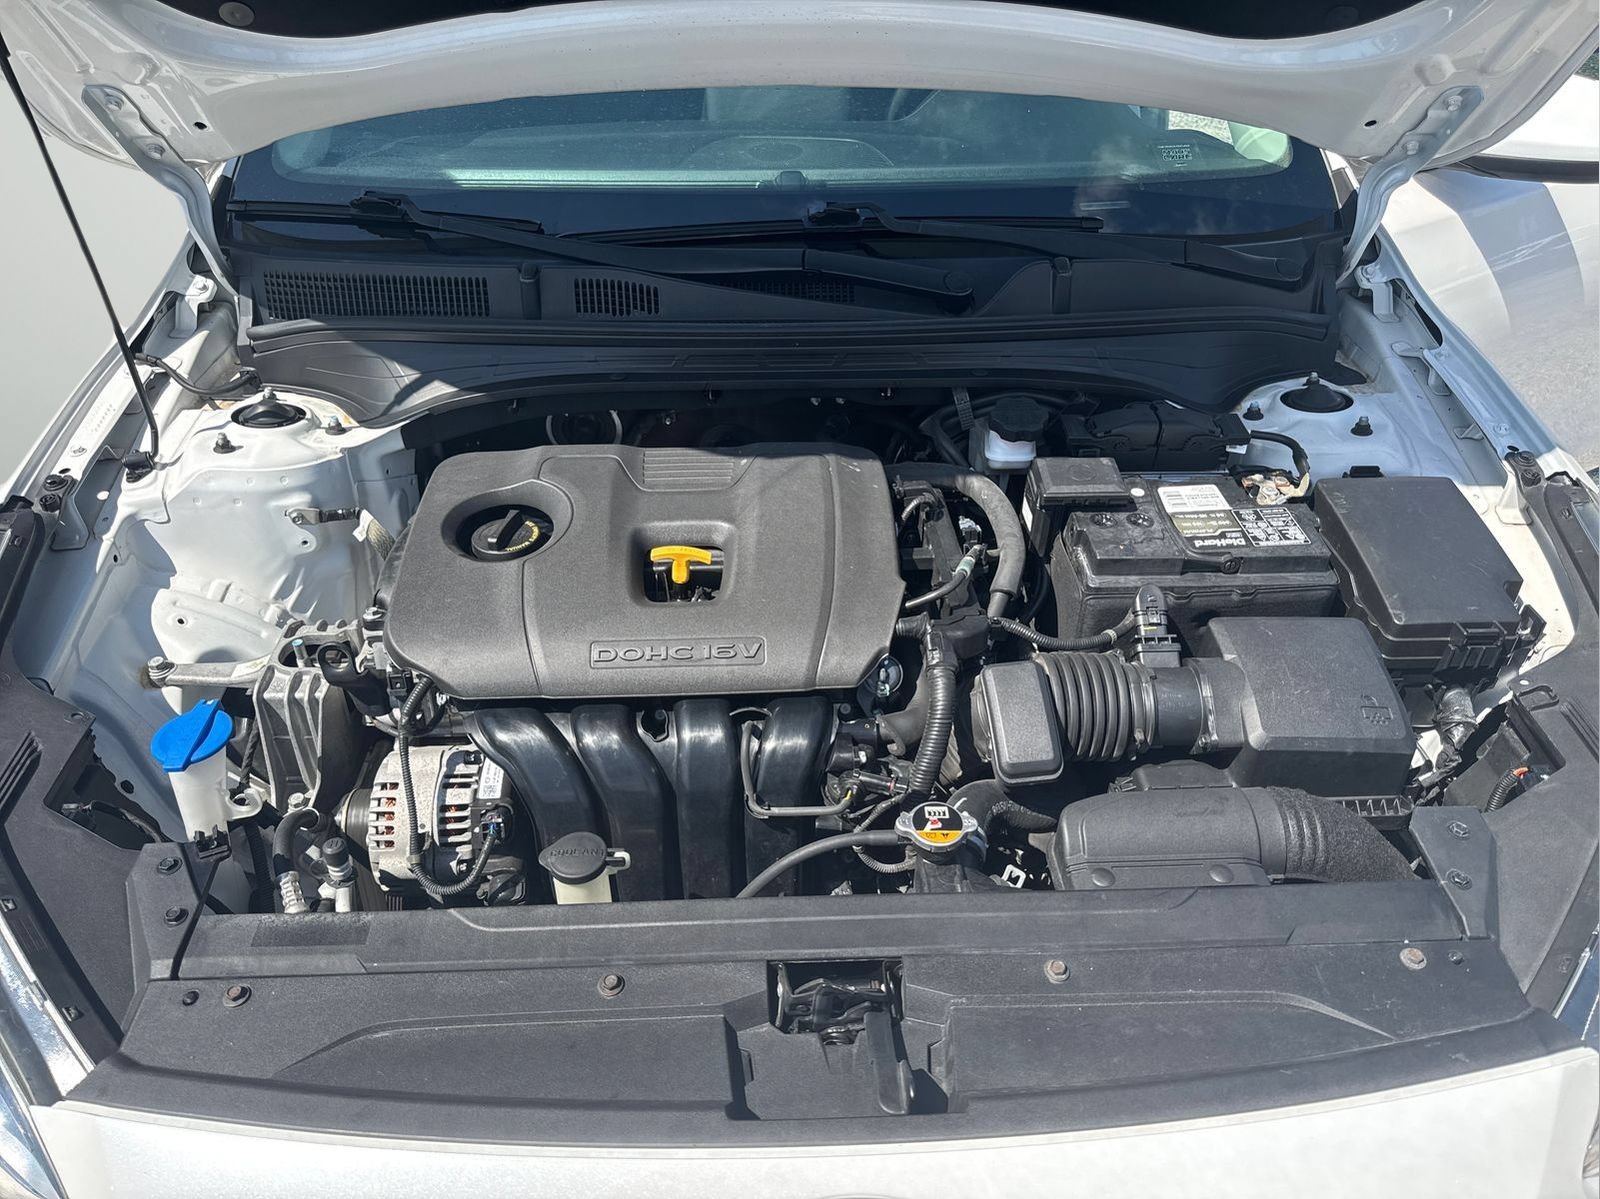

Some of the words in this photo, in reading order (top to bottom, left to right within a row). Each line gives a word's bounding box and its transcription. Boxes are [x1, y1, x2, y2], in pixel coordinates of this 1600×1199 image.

[1194, 538, 1246, 547] DieHard
[593, 646, 694, 662] DOHC
[703, 643, 762, 660] 16V
[550, 847, 605, 859] COOLANT
